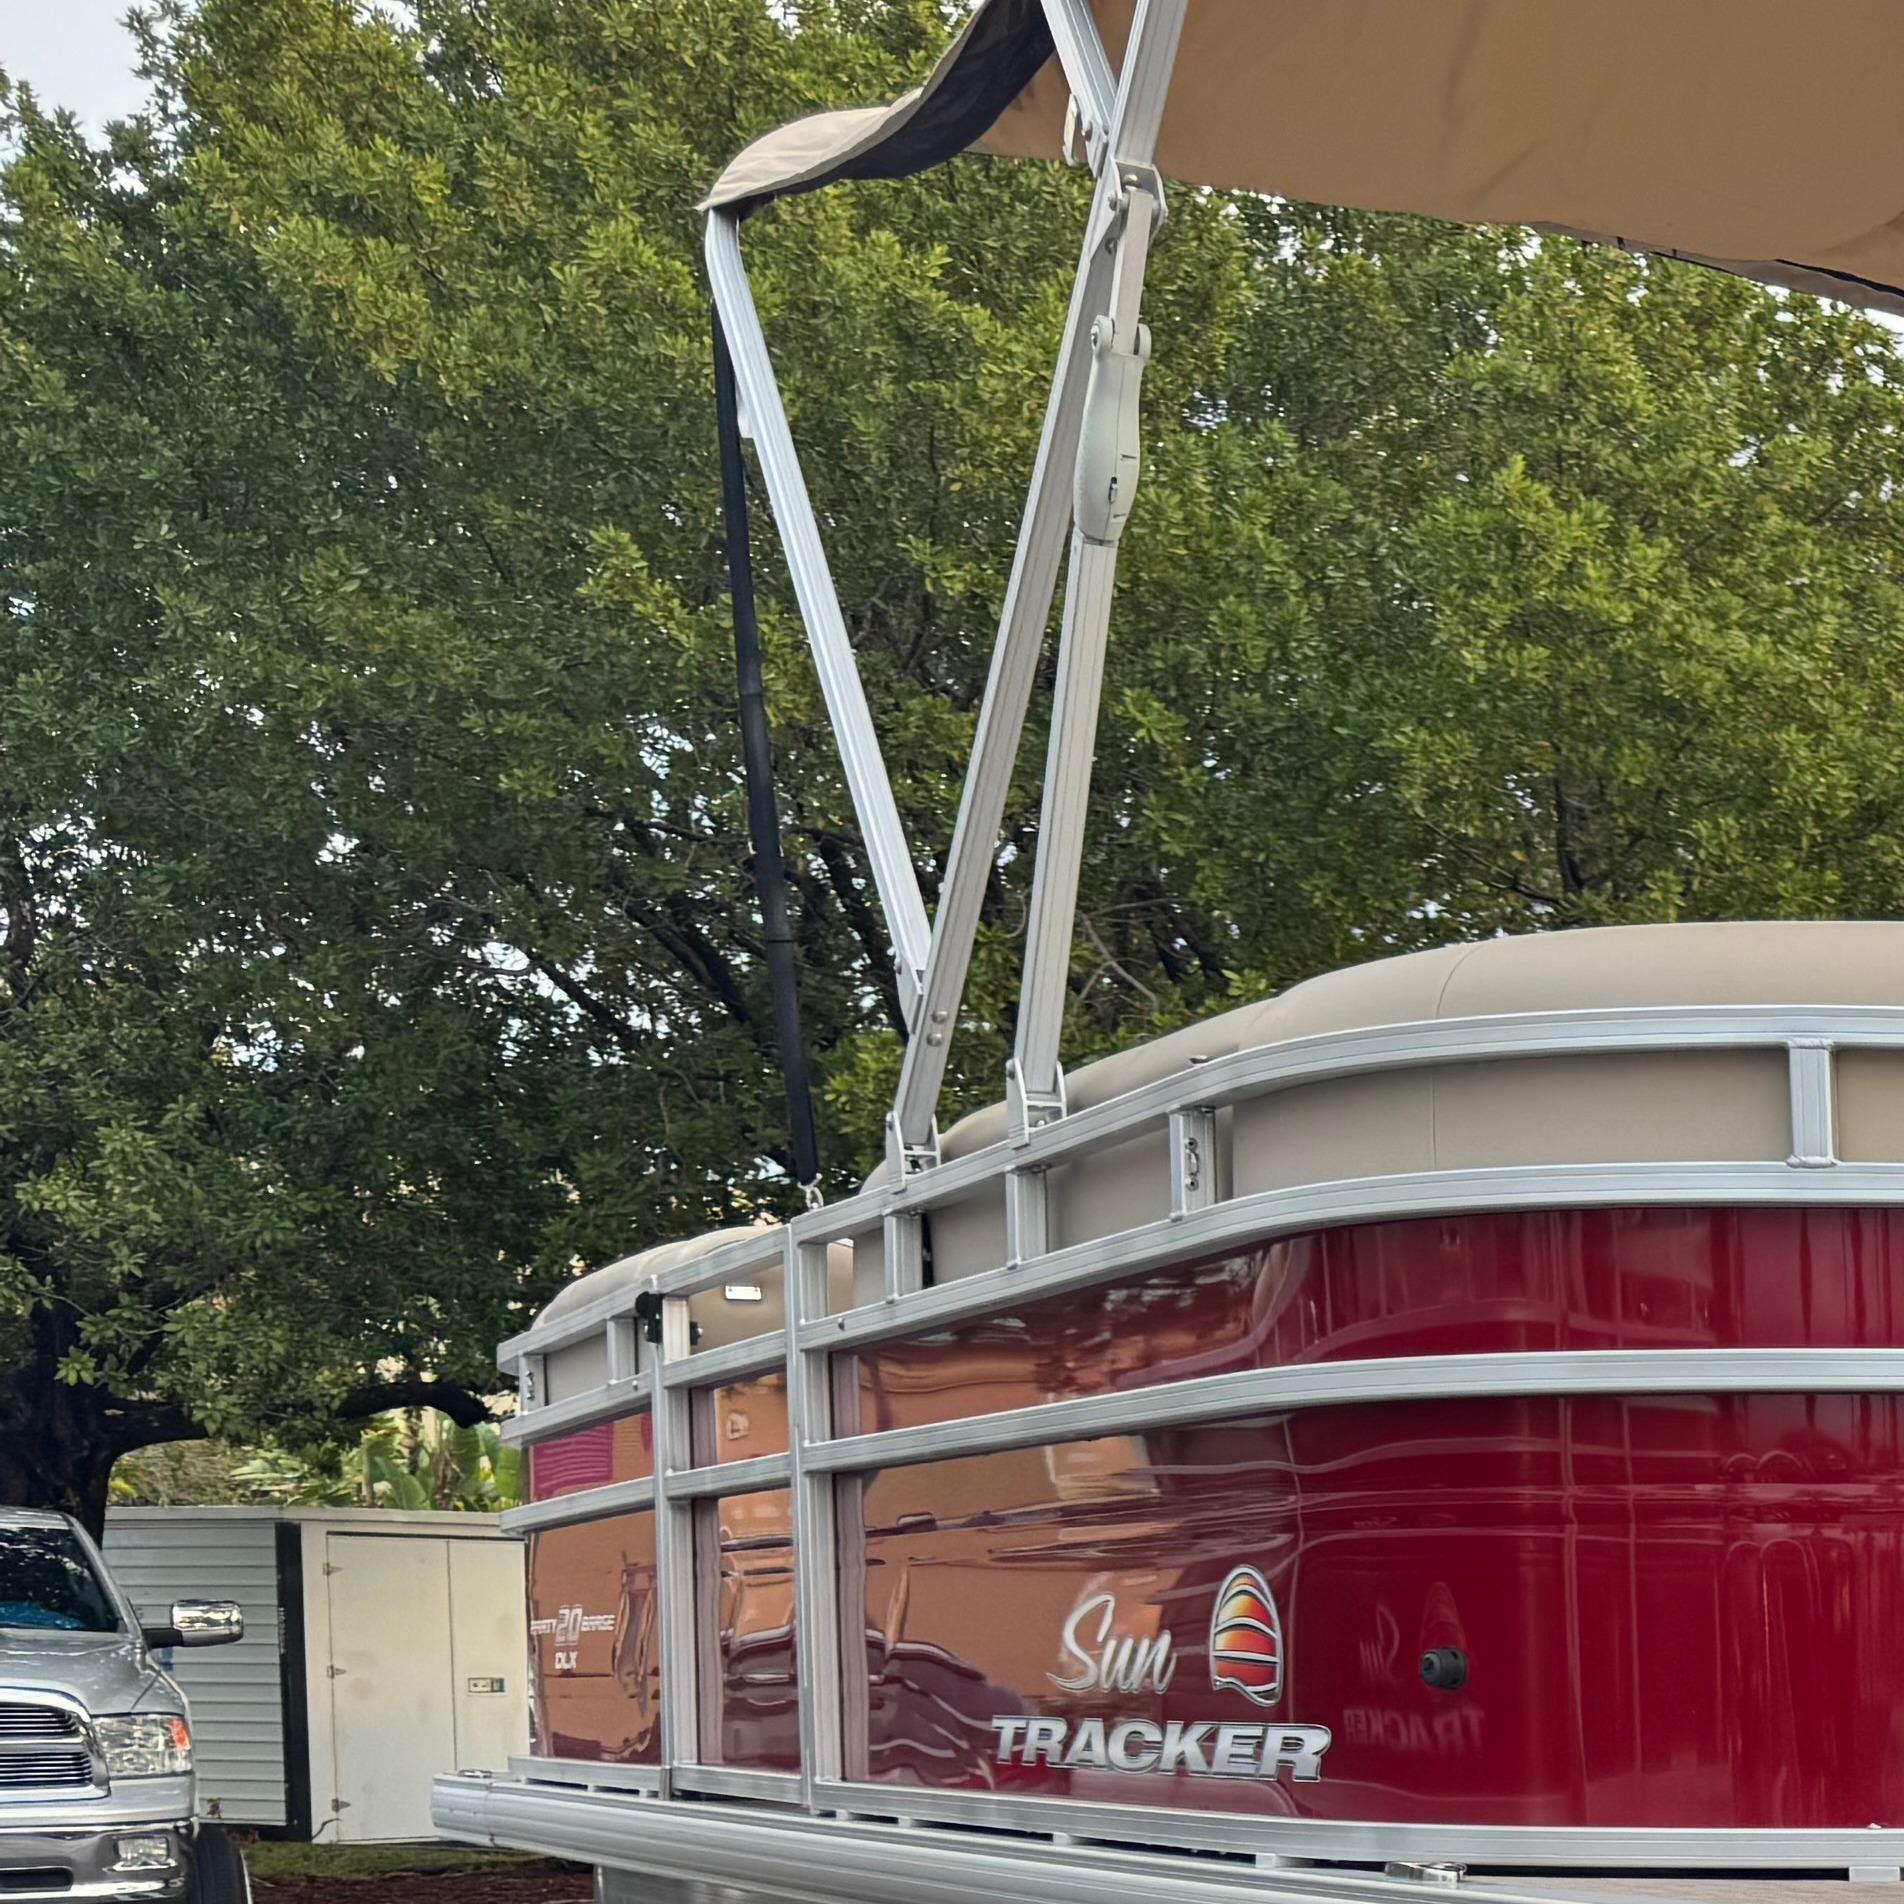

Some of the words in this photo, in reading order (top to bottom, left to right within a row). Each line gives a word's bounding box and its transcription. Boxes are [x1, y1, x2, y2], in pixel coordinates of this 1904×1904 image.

[555, 1604, 583, 1646] 20
[1046, 1592, 1177, 1694] Sun
[554, 1651, 578, 1670] DLX
[992, 1715, 1332, 1783] TRACKER
